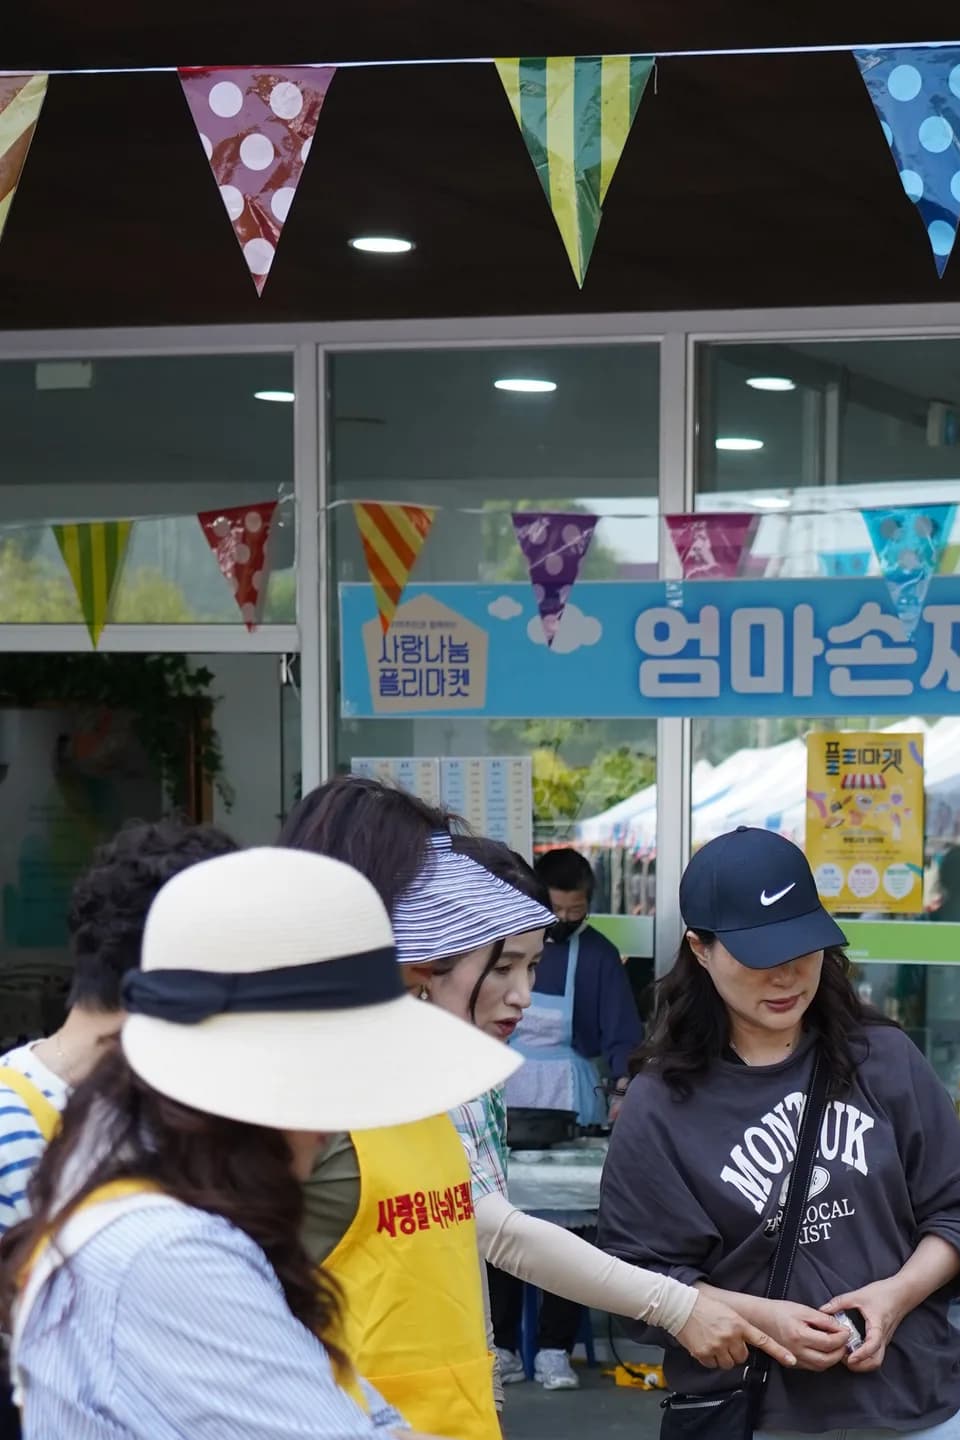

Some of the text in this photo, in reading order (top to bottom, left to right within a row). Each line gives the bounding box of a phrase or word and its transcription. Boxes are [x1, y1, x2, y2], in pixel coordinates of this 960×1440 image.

[378, 634, 470, 664] 사랑나눔
[379, 668, 470, 697] 플리마켓
[825, 742, 904, 776] 플리마켓
[376, 1191, 430, 1237] 사랑을
[802, 1198, 855, 1225] OCAL
